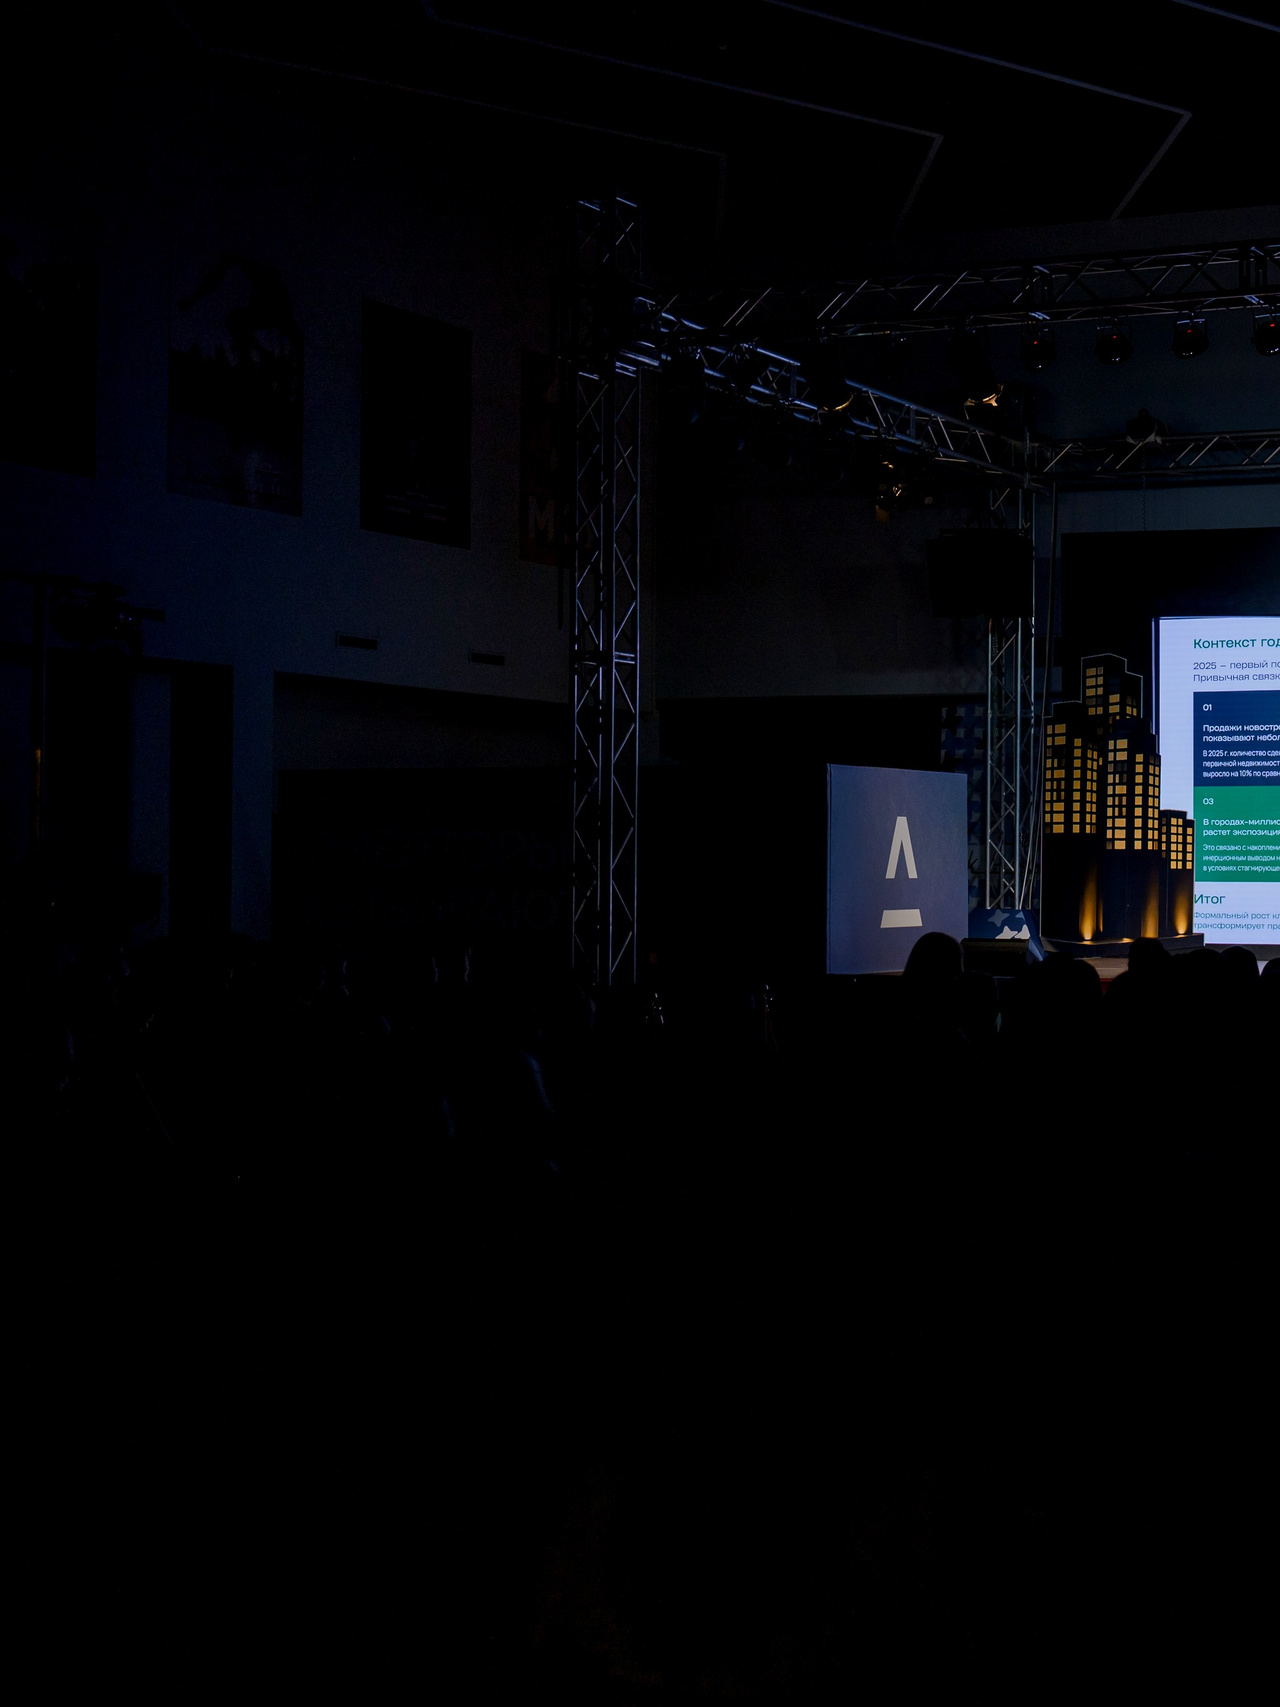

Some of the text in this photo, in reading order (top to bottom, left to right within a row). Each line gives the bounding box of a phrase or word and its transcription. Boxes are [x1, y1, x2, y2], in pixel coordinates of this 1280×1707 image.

[1194, 638, 1257, 649] Контекст
[1193, 662, 1217, 670] 2025
[1230, 660, 1268, 670] первый
[1193, 673, 1250, 683] Привычная
[1203, 724, 1242, 733] Продажи
[1203, 760, 1237, 769] первичной
[1203, 771, 1231, 779] выросло
[1194, 894, 1225, 904] Итог
[1194, 922, 1265, 930] трансформирует
